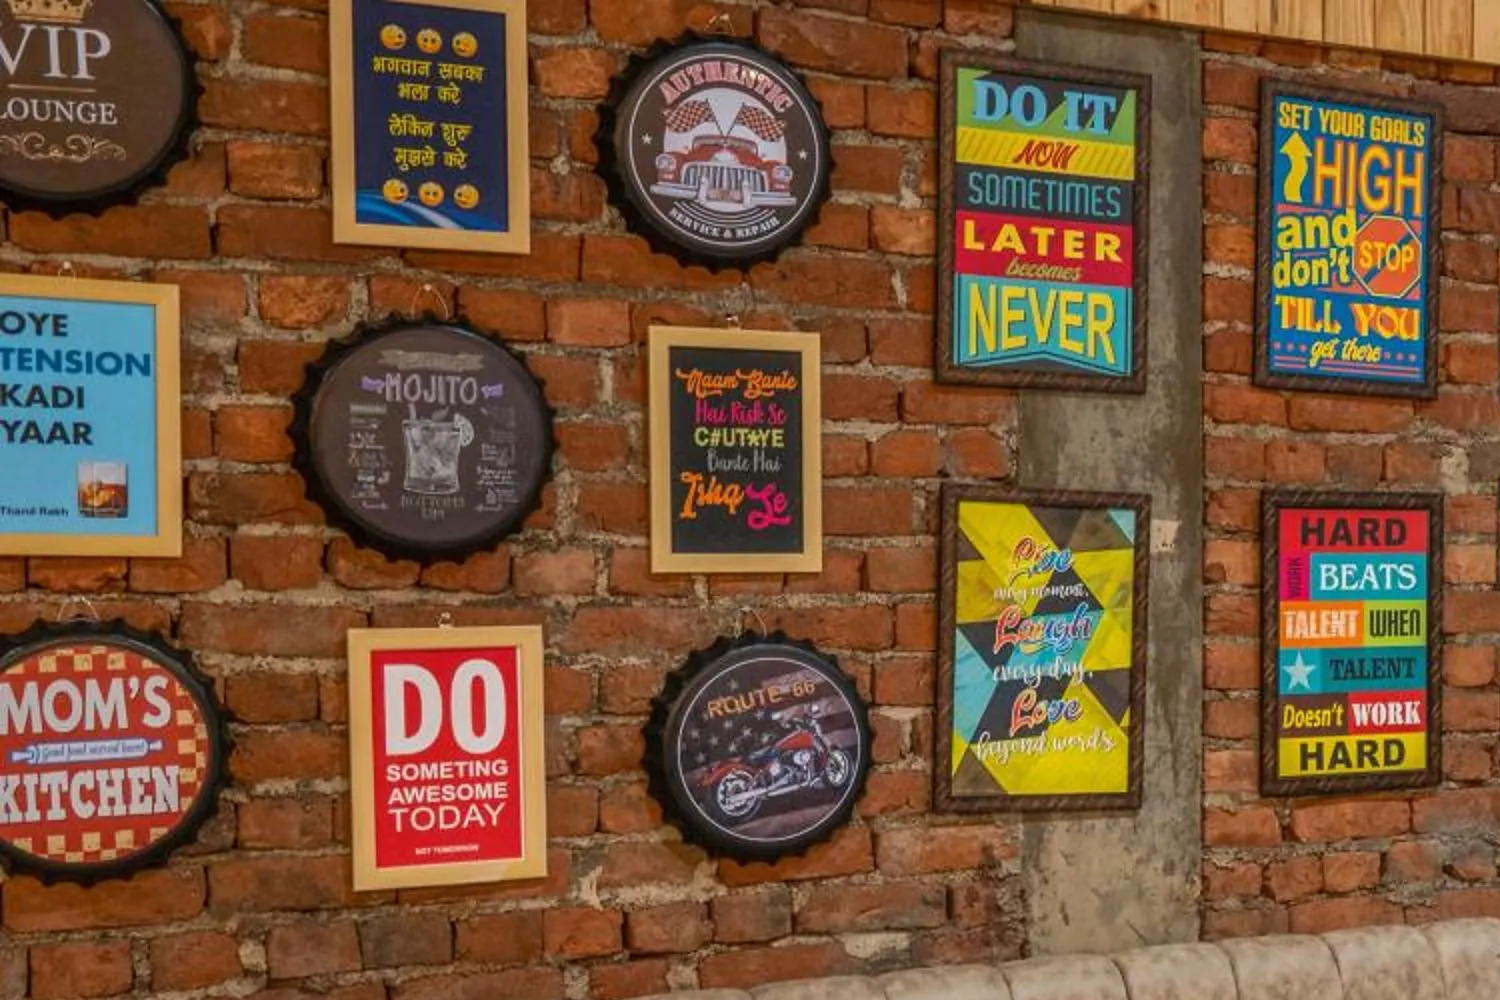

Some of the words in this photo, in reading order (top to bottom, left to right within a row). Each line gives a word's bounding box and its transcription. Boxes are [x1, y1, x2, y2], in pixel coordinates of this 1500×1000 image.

[0, 24, 112, 80] VIP
[658, 61, 794, 113] AUTHENTIC
[970, 78, 1048, 128] DO
[1062, 90, 1117, 136] IT
[1279, 102, 1313, 131] SET
[1317, 107, 1366, 139] YOUR
[1369, 116, 1426, 148] GOALS
[1013, 138, 1079, 171] NOW
[1313, 136, 1426, 216] HIGH
[967, 170, 1122, 218] SOMETIMES
[668, 206, 720, 238] SERVICE
[735, 217, 780, 239] REPAIR
[1276, 207, 1358, 251] and
[963, 219, 1123, 263] LATER
[1359, 240, 1416, 273] STOP
[1005, 256, 1083, 282] becomes
[1273, 247, 1352, 289] don't
[0, 311, 68, 337] OYE
[967, 282, 1116, 366] NEVER
[1274, 295, 1343, 335] TILL
[1350, 302, 1421, 342] YOU
[0, 347, 151, 377] TENSION
[1309, 337, 1341, 368] get
[1340, 336, 1383, 364] there
[0, 383, 85, 410] KADI
[385, 372, 478, 405] MOJITO
[0, 419, 94, 446] YAAR
[1301, 516, 1408, 548] HARD
[1319, 562, 1418, 592] BEATS
[1283, 609, 1360, 640] TALENT
[1369, 608, 1421, 638] WHEN
[1328, 656, 1418, 683] TALENT
[0, 674, 172, 735] MOM'S
[383, 657, 507, 757] DO
[707, 685, 783, 719] ROUTE
[793, 679, 817, 698] 66
[1009, 688, 1084, 738] Love
[1282, 701, 1344, 730] Doesn't
[1351, 700, 1422, 728] WORK
[386, 759, 509, 782] SOMETING
[1299, 738, 1407, 772] HARD
[0, 765, 181, 824] KITCHEN
[388, 781, 509, 805] AWESOME
[388, 802, 506, 833] TODAY
